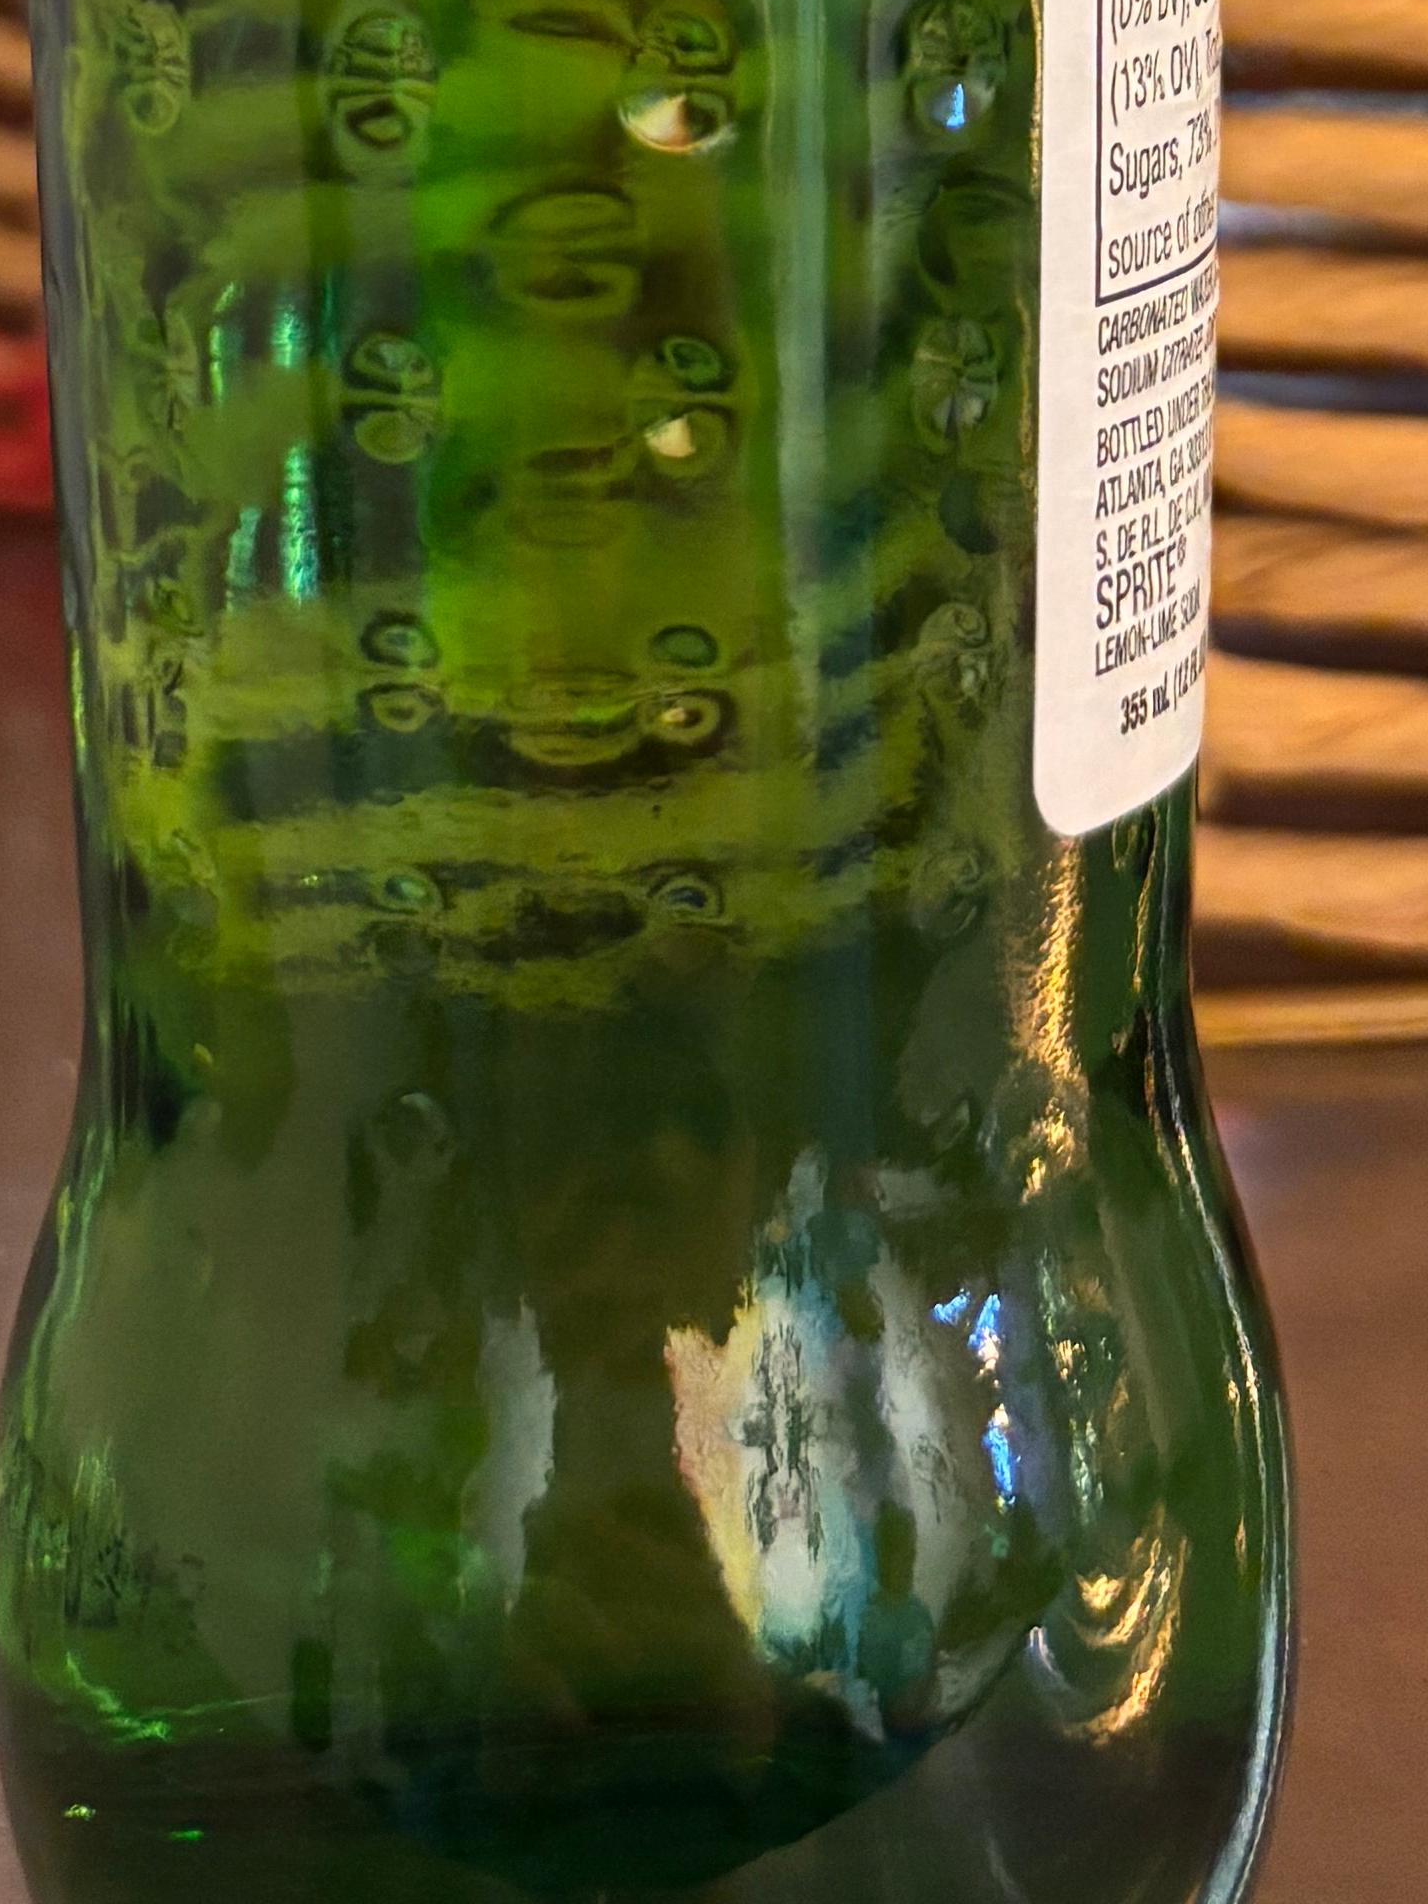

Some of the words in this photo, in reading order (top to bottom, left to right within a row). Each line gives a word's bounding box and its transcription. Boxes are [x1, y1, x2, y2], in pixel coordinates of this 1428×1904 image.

[1111, 49, 1165, 127] (13%
[1109, 136, 1183, 200] Sugars,
[1108, 219, 1173, 279] source
[1176, 196, 1191, 253] of
[1097, 283, 1188, 355] CARBONATED
[1097, 348, 1158, 408] SODIUM
[1096, 405, 1165, 468] BOTTLED
[1167, 381, 1200, 438] UNDER
[1095, 455, 1166, 520] ATLANTA,
[1169, 443, 1185, 487] GA
[1095, 529, 1112, 572] S.
[1117, 517, 1138, 564] DE
[1167, 492, 1183, 538] DE
[1095, 600, 1178, 676] LEMON-LIME
[1120, 687, 1148, 735] 355
